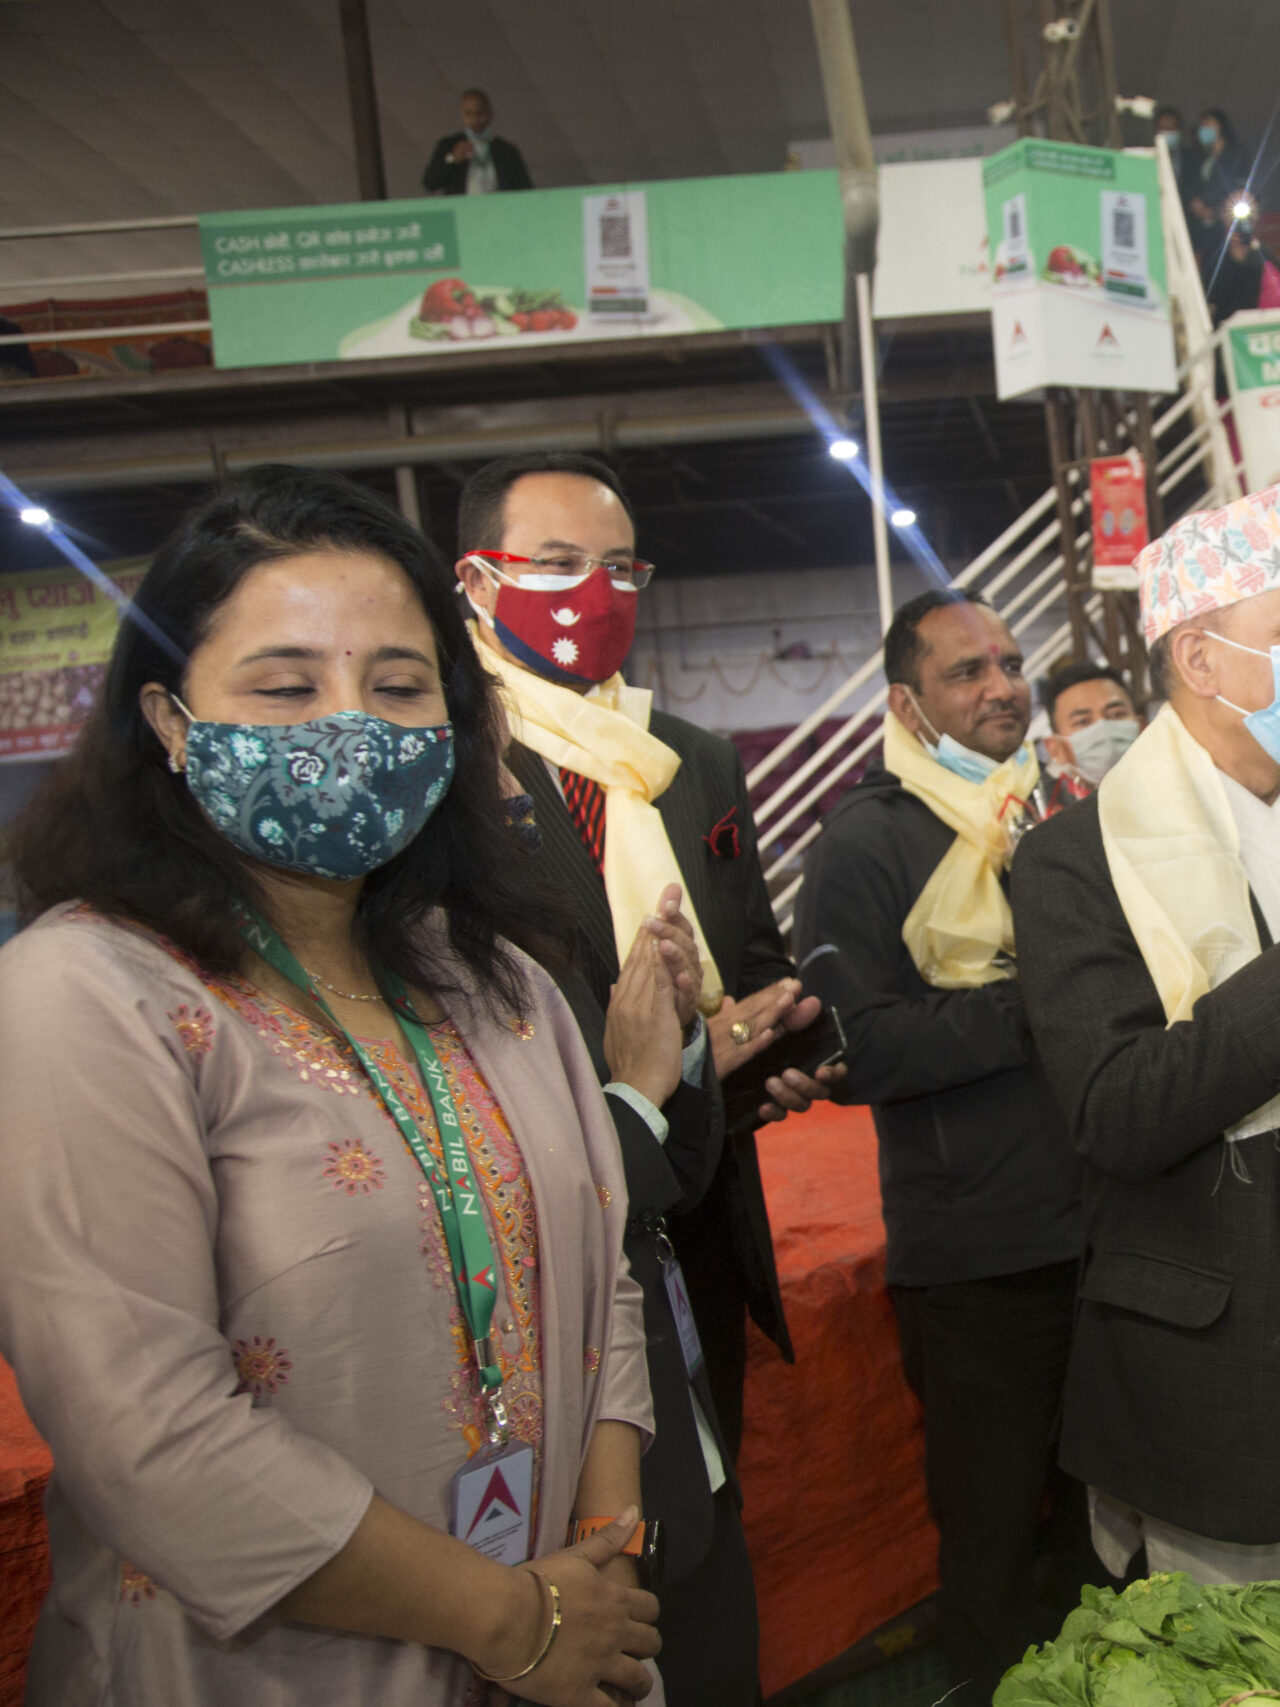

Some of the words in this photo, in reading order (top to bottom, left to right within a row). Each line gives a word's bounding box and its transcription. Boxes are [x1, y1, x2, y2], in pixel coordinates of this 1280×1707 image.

[215, 236, 260, 254] CASH
[296, 230, 321, 248] QR
[217, 256, 295, 277] CASHLESS
[423, 1056, 458, 1127] BANK
[411, 1129, 451, 1212] NABIL
[448, 1136, 479, 1215] NABIL
